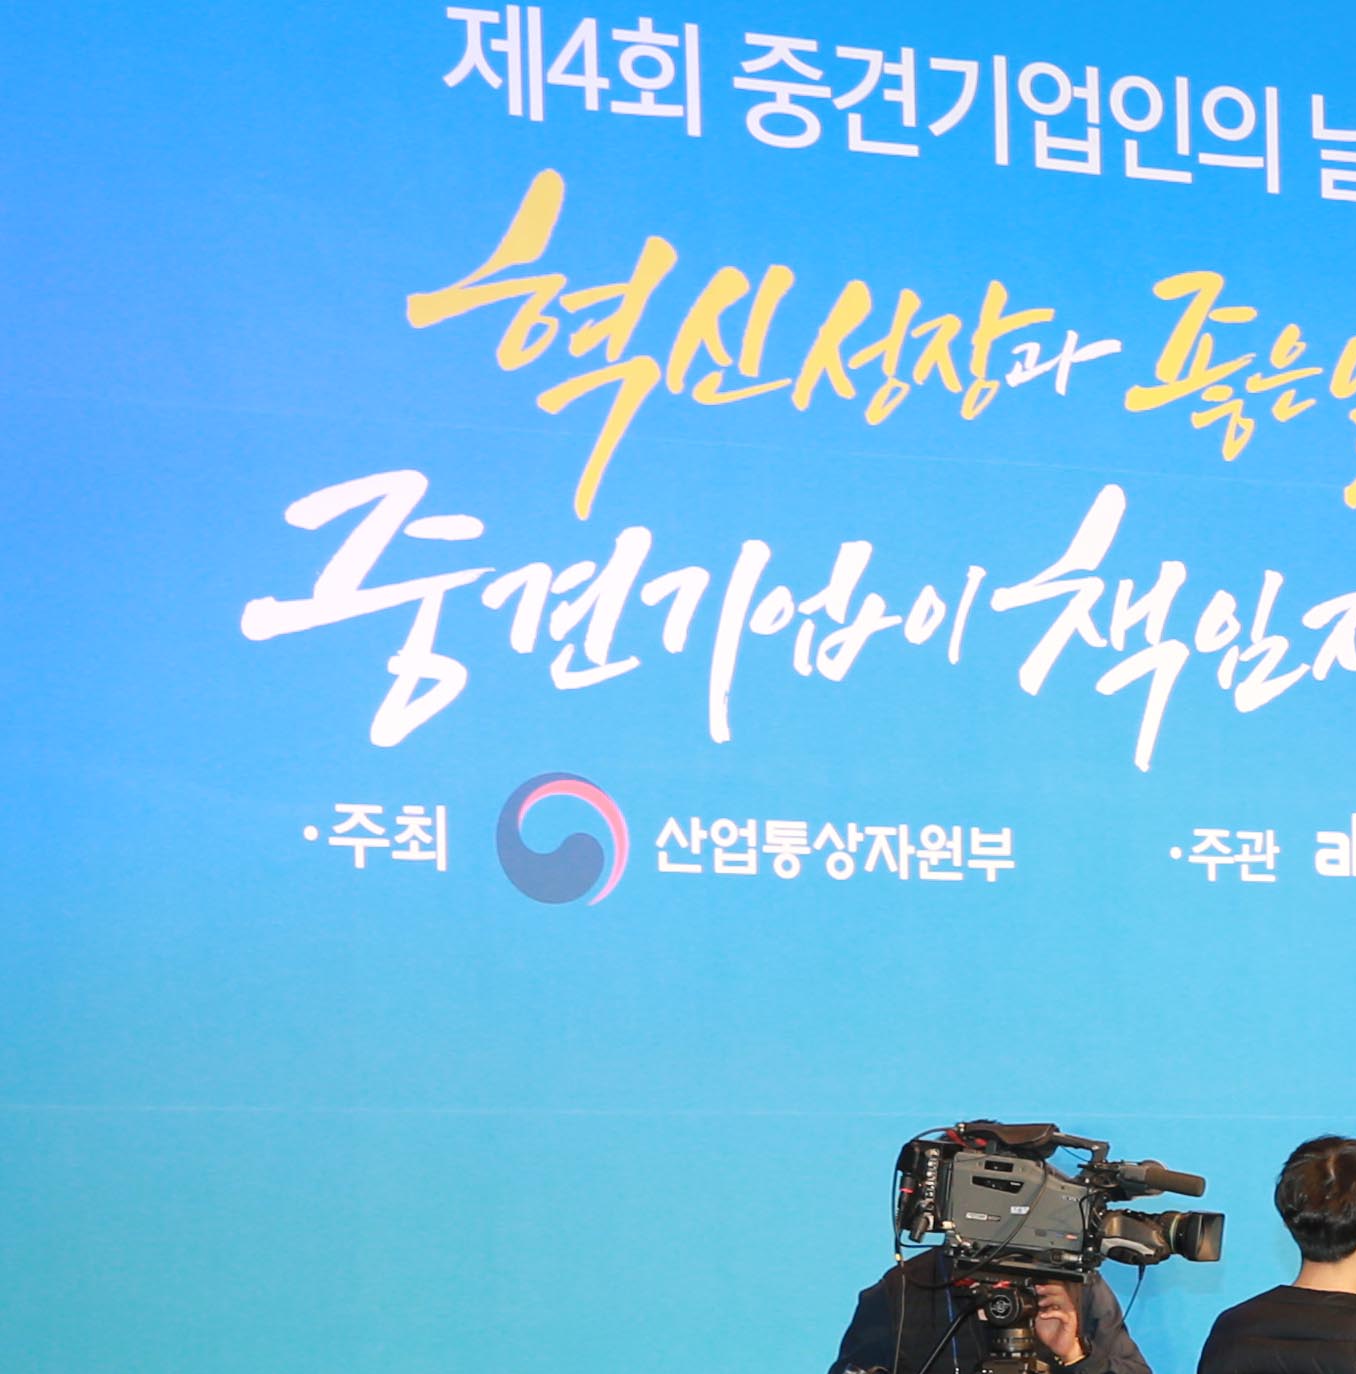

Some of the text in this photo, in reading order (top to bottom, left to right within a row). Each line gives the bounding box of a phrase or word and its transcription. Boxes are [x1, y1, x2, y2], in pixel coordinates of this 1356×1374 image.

[442, 4, 703, 138] 제4회
[732, 31, 1281, 195] 중견기업인의
[239, 468, 988, 749] 중견기업이
[654, 815, 1017, 884] 산업통상자원부
